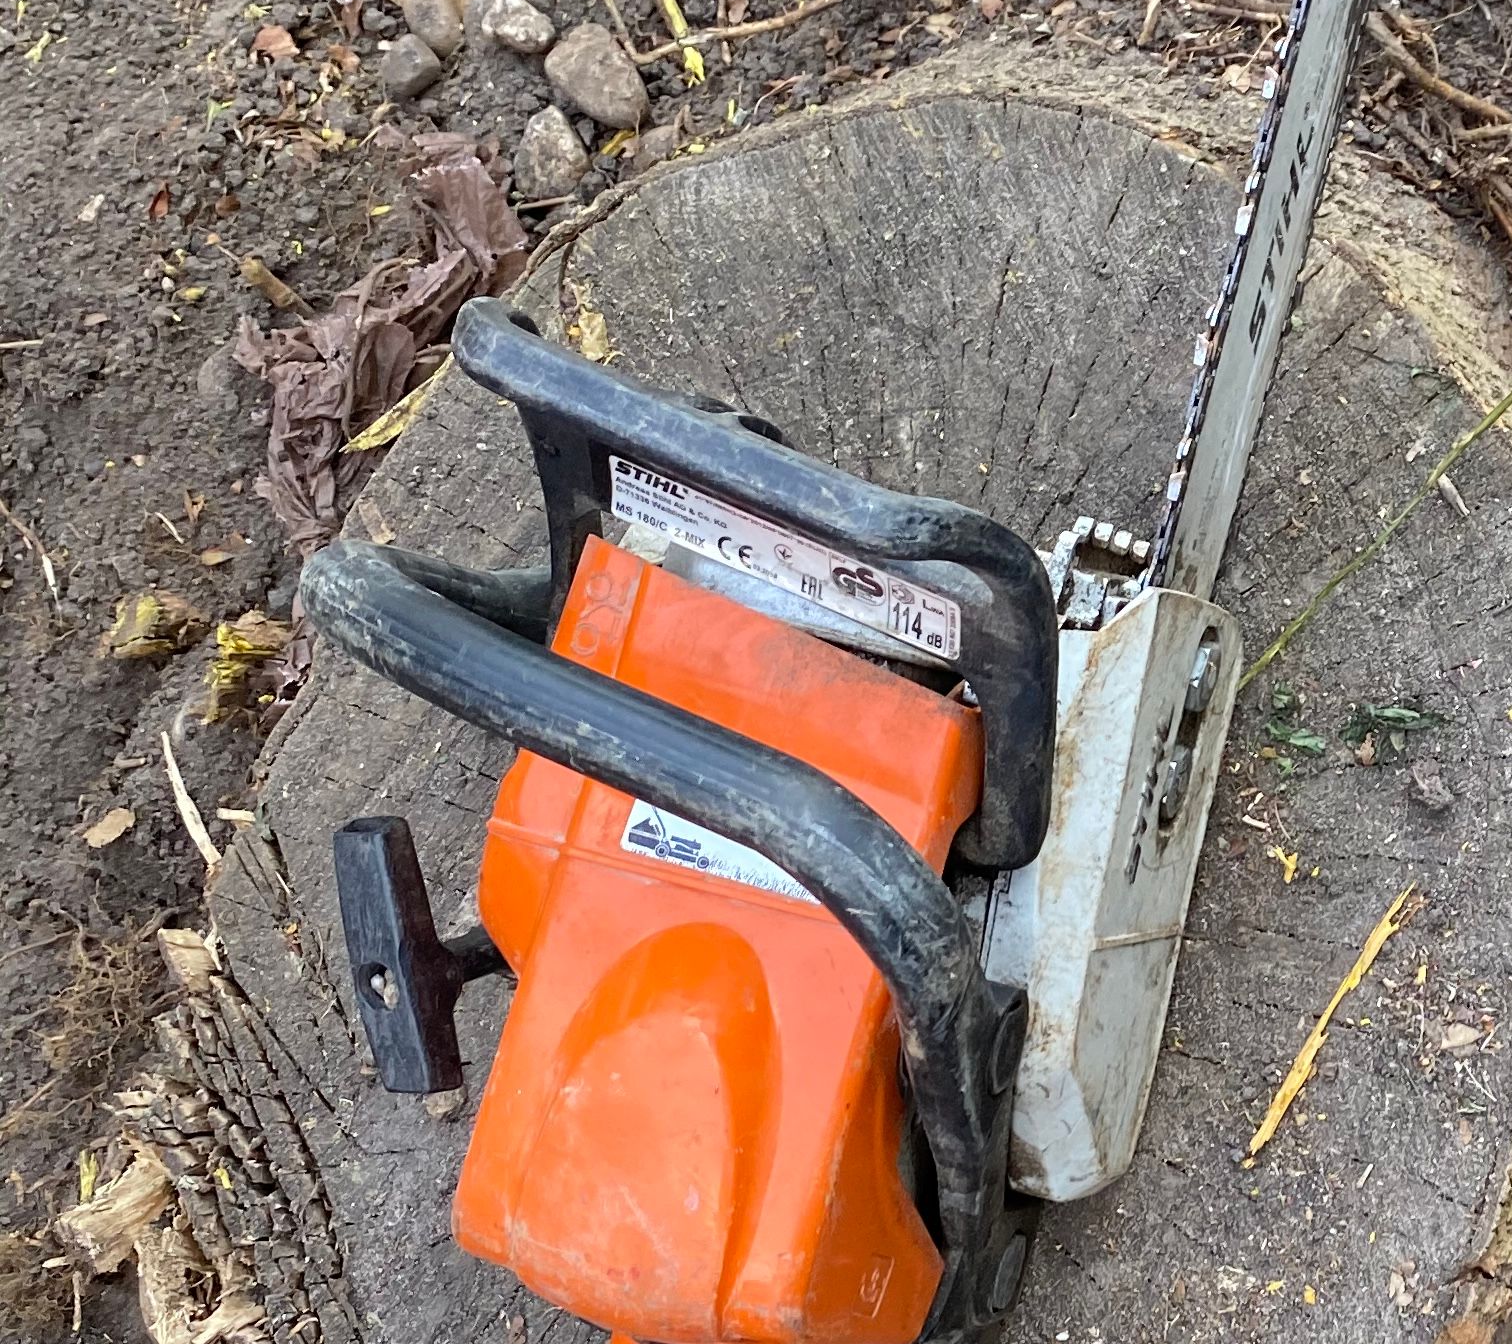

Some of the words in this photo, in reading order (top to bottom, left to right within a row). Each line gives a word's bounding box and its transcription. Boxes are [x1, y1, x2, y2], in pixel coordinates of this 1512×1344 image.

[615, 501, 633, 517] MS
[636, 511, 668, 532] 180/C
[673, 527, 706, 549] 2-MIX
[892, 602, 923, 640] 114
[926, 632, 943, 649] dB
